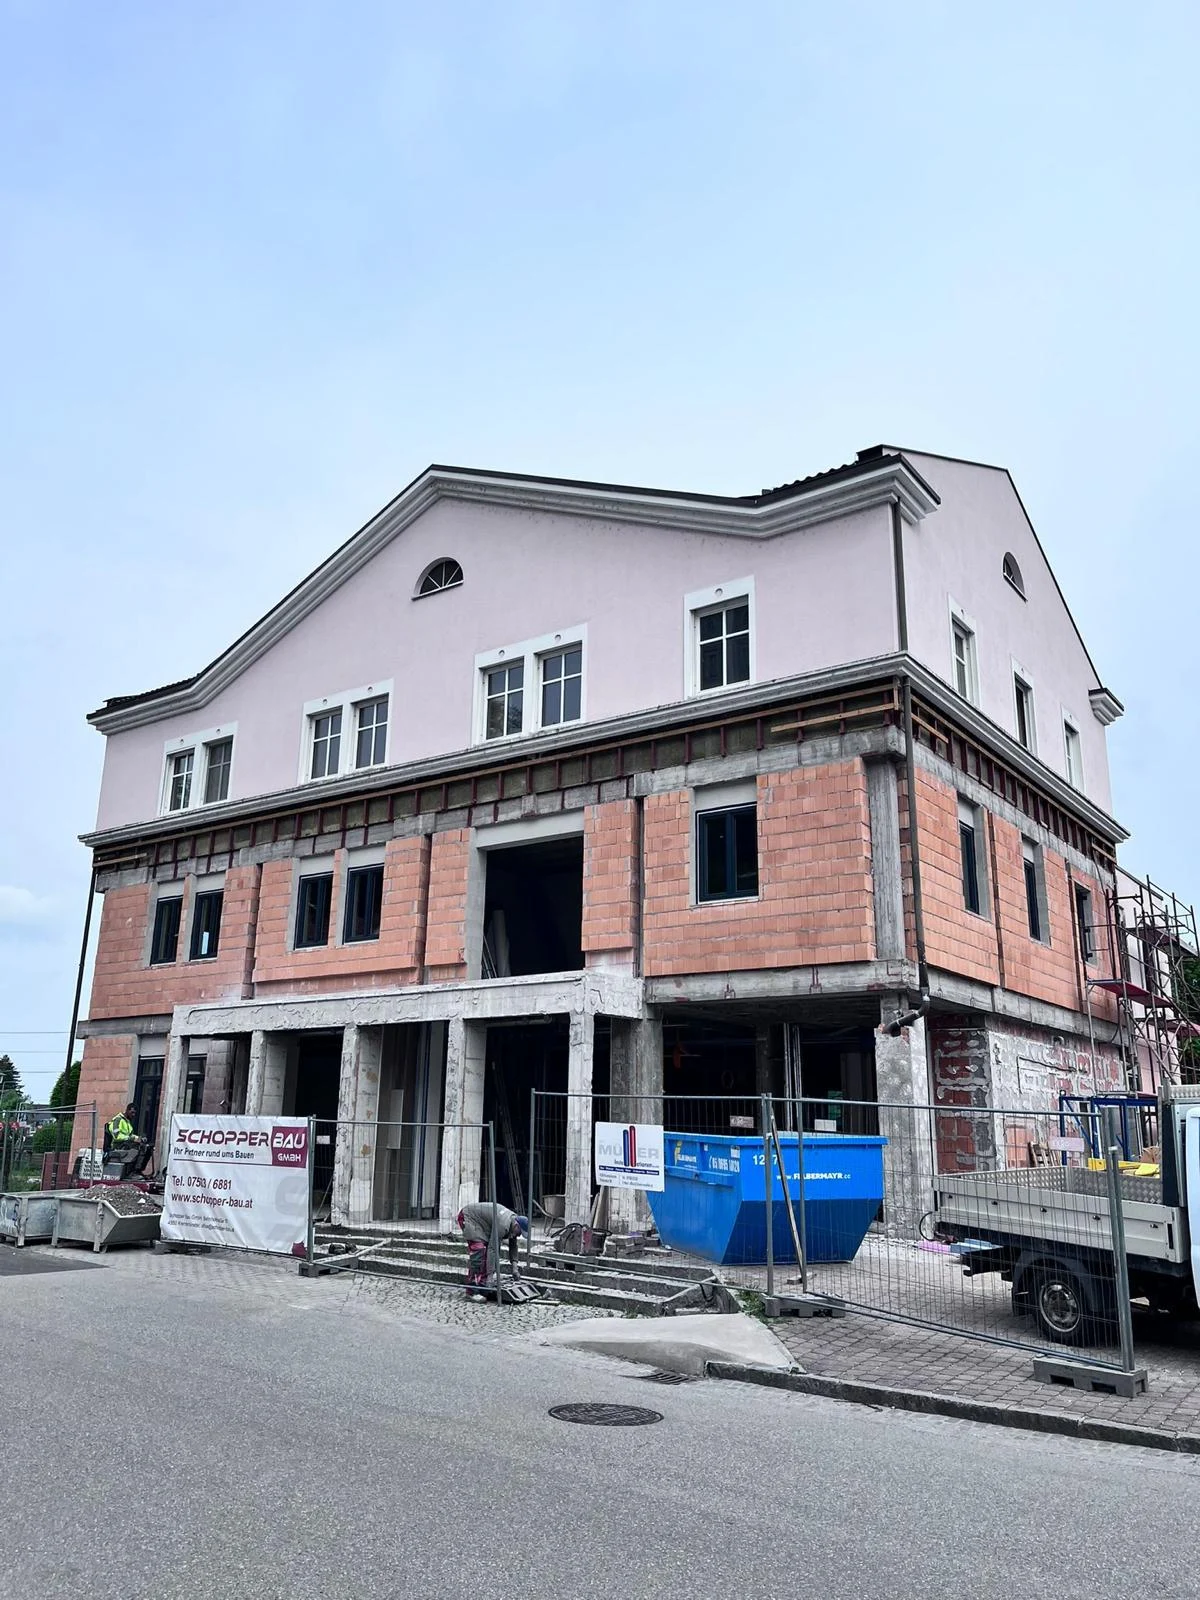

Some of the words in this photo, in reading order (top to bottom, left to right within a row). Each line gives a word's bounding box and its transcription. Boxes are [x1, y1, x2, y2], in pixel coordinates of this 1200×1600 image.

[176, 1129, 270, 1147] SCHOPPER
[272, 1132, 306, 1149] BAU
[205, 1149, 220, 1158] rund
[221, 1151, 234, 1159] ums
[235, 1150, 254, 1159] Bauen
[753, 1154, 778, 1165] 127
[776, 1172, 852, 1180] ww.FLBERMAYR.cc
[172, 1175, 185, 1187] Tel.
[212, 1178, 232, 1190] 6881
